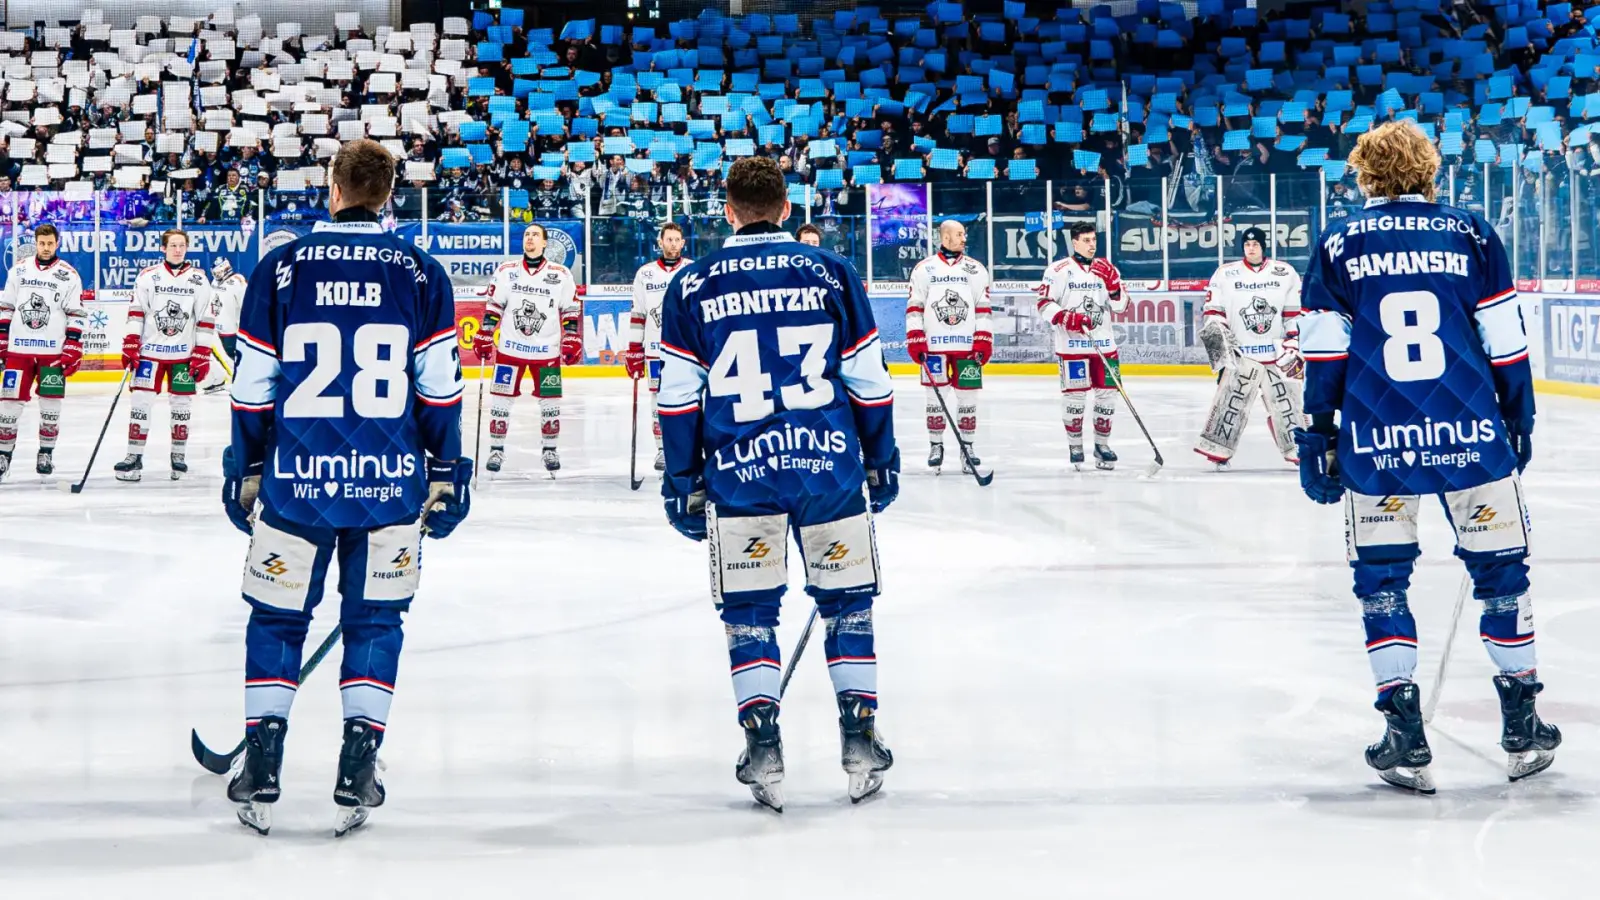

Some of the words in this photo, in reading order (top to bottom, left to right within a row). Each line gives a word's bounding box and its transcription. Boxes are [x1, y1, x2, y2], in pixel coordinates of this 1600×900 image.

[60, 230, 118, 253] NUR
[125, 230, 164, 253] DE
[187, 230, 252, 253] EVW
[437, 234, 503, 250] WEIDEN
[108, 256, 129, 268] Die
[1345, 251, 1469, 282] SAMANSKI
[315, 281, 382, 308] KOLB
[1234, 280, 1281, 290] Buderus
[700, 286, 828, 324] RIBNITZKY
[14, 338, 57, 348] STEMMLE
[82, 340, 110, 349] ärme!
[504, 340, 549, 353] STEMMLE
[931, 335, 973, 345] STEMMLE
[1112, 324, 1176, 346] CHEN
[1379, 290, 1446, 382] 8
[41, 374, 64, 385] AOK
[283, 322, 410, 418] 28
[708, 323, 835, 423] 43
[1217, 367, 1255, 441] ZANKL
[714, 422, 848, 471] Luminus
[1350, 416, 1496, 455] Luminus
[273, 446, 416, 480] Luminus
[735, 463, 766, 484] Wir
[780, 454, 834, 474] Energie
[1372, 454, 1401, 471] Wir
[1421, 450, 1481, 471] Energie
[293, 482, 321, 499] Wir
[343, 482, 403, 502] Energie
